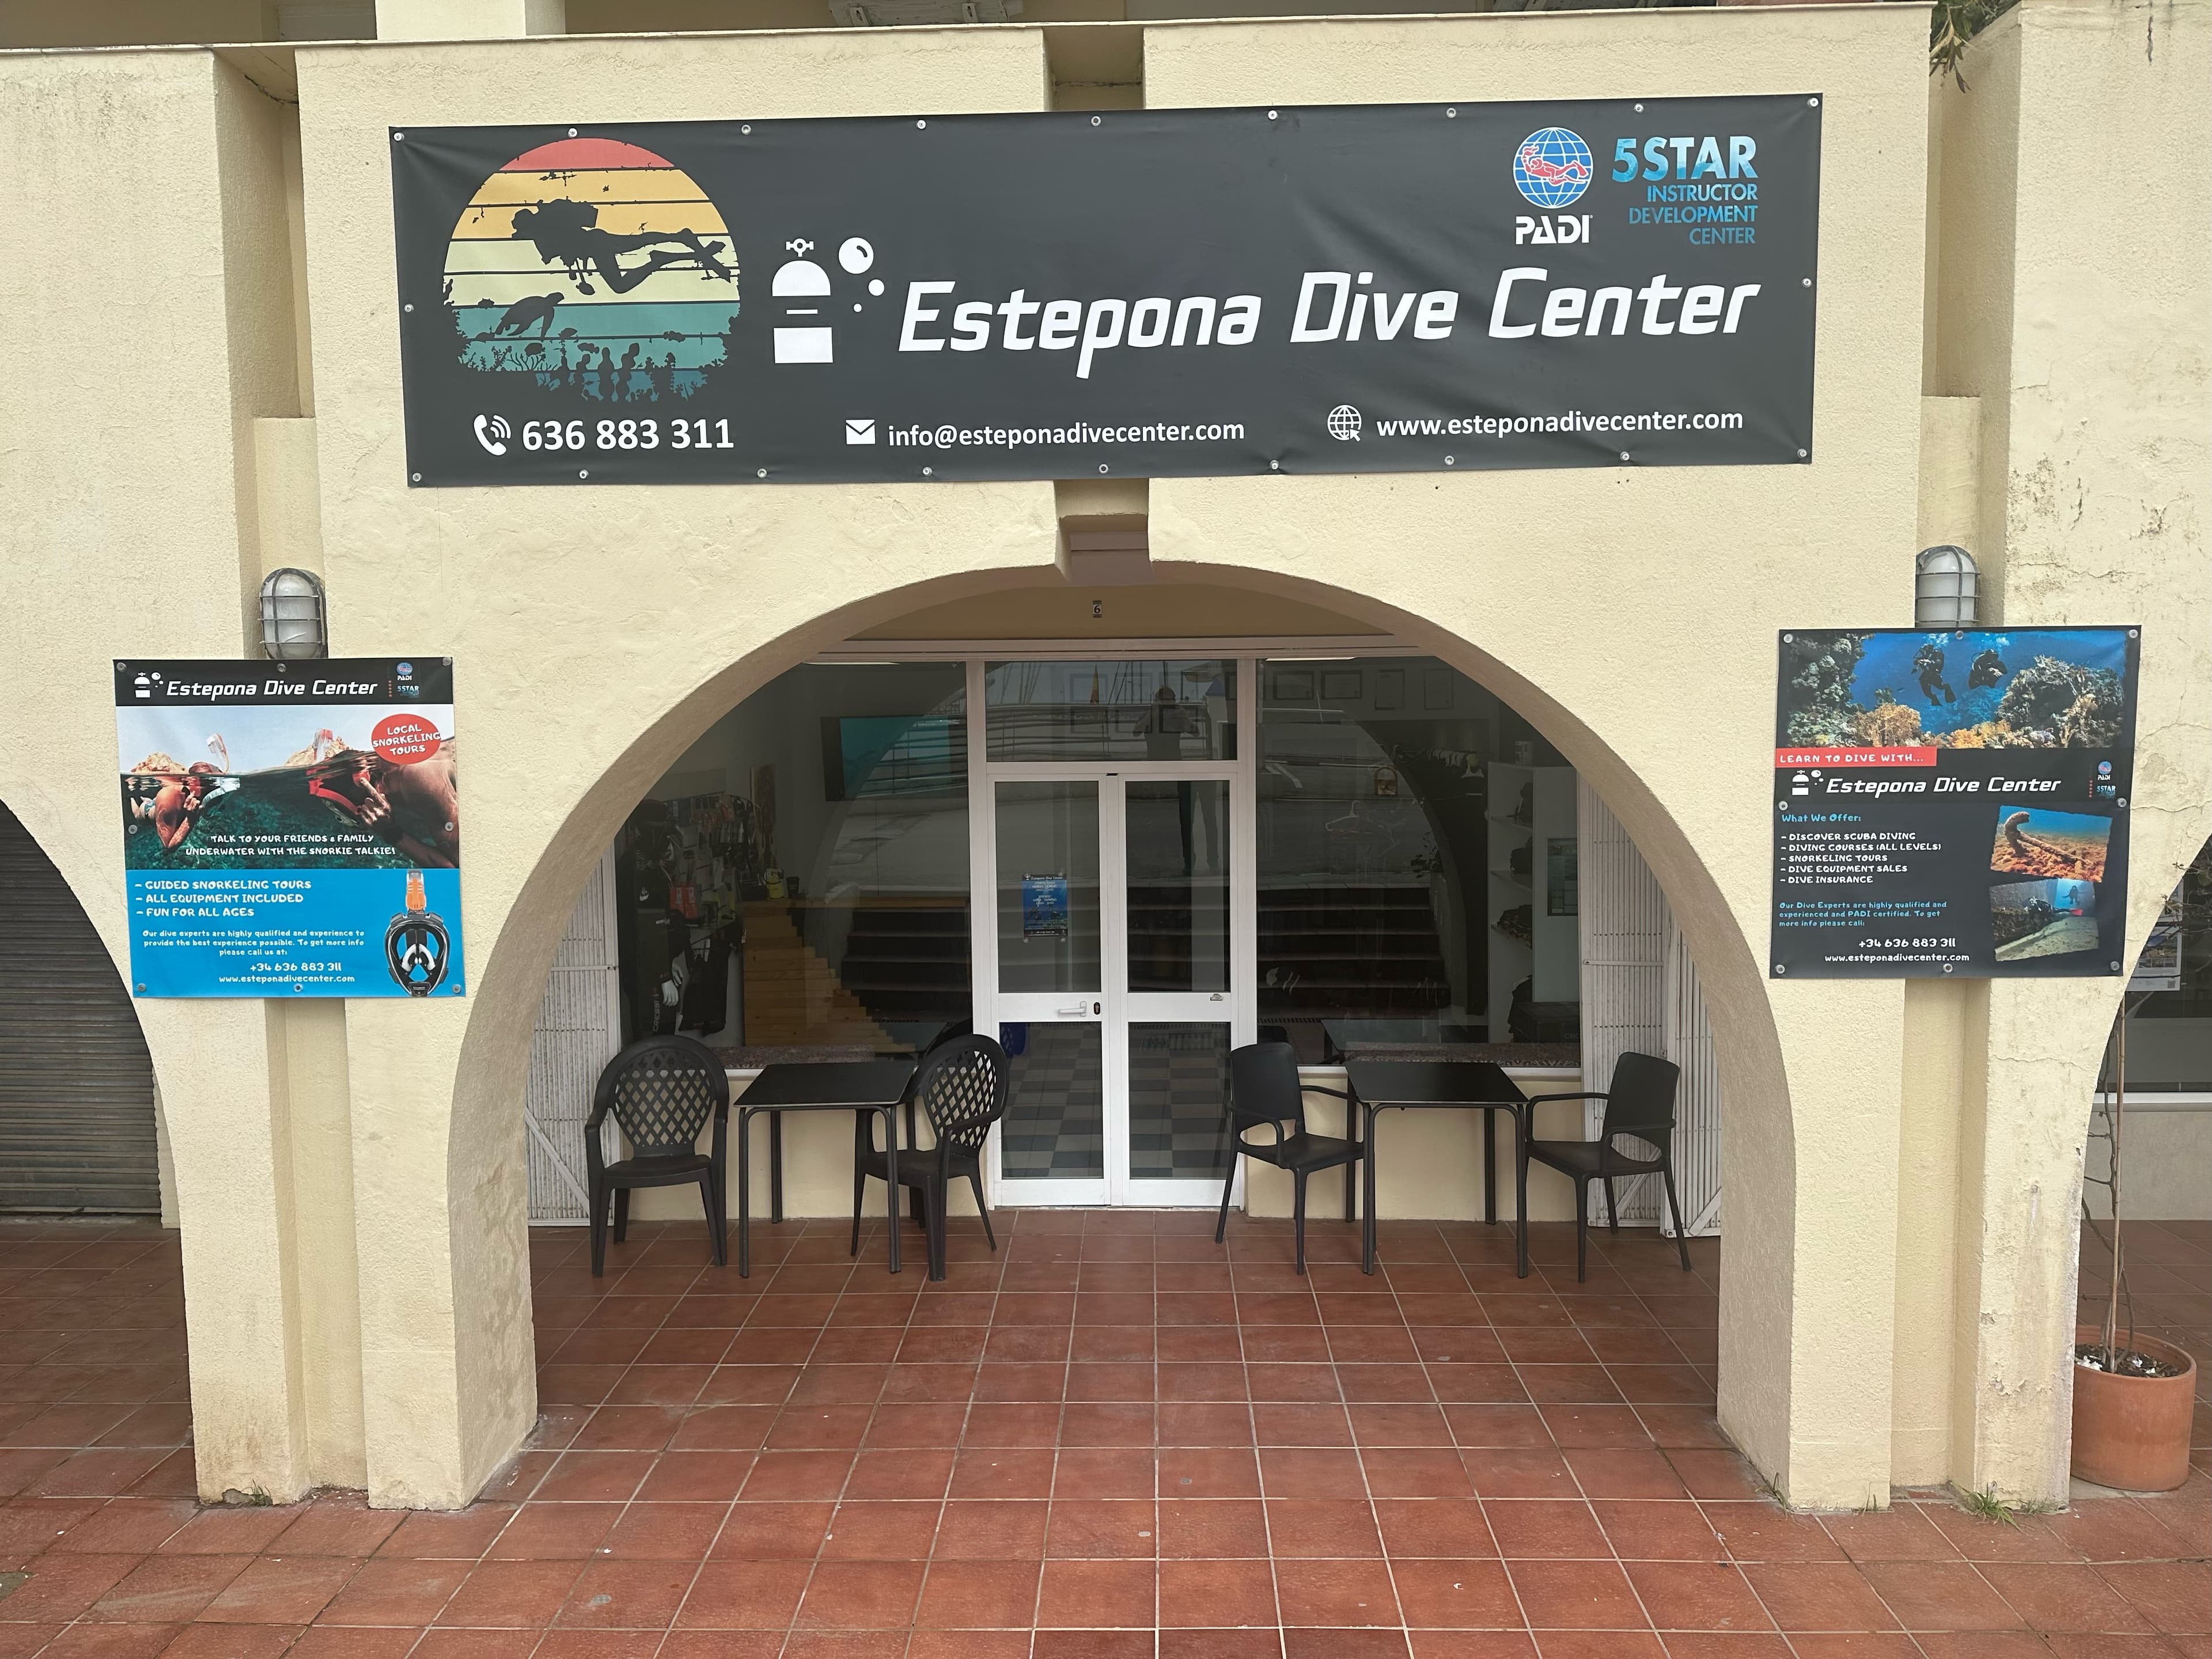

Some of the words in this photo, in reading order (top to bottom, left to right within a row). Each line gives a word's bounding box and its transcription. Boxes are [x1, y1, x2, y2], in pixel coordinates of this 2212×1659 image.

[1647, 184, 1758, 202] INSTRUCTOR
[1628, 206, 1758, 225] DEVELOPMENT
[1516, 215, 1589, 244] PADI
[1689, 228, 1755, 245] CENTER
[899, 281, 1261, 378] Estepona
[1290, 272, 1458, 342] Dive
[1488, 267, 1761, 338] Center
[1377, 411, 1743, 438] www.esteponadivecenter.com
[523, 421, 585, 450] 636
[597, 419, 659, 449] 883
[671, 419, 734, 449] 311
[889, 422, 1244, 449] info@esteponadivecenter.com
[1094, 605, 1101, 613] 6
[166, 681, 257, 701] Estepona
[264, 680, 305, 695] Dive
[312, 680, 378, 695] Center
[387, 724, 422, 735] LOCAL
[373, 732, 441, 748] SNORKELING
[389, 745, 425, 755] TOURS
[1845, 754, 1876, 762] DIVE
[1881, 753, 1923, 762] WITH...
[1826, 778, 1926, 798] Estepona
[1933, 778, 1980, 792] Dive
[1987, 777, 2061, 791] Center
[1782, 814, 1808, 822] What
[1830, 813, 1861, 821] Offer:
[210, 835, 236, 843] TALK
[186, 846, 255, 855] UNDERWATER
[286, 847, 307, 855] THE
[309, 847, 353, 855] SNORKIE
[145, 881, 189, 889] GUIDED
[192, 880, 269, 889] SNORKELING
[272, 880, 311, 889] TOURS
[146, 894, 167, 903] ALL
[170, 894, 239, 903] EQUIPMENT
[242, 894, 304, 903] INCLUDED
[1817, 902, 1850, 910] Experts
[146, 908, 169, 916] FUN
[172, 908, 195, 916] FOR
[198, 908, 219, 916] ALL
[223, 907, 254, 916] AGES
[1779, 911, 1828, 919] experienced
[144, 940, 174, 948] provide
[213, 940, 257, 948] experience
[259, 939, 295, 947] possible.
[1859, 939, 1881, 948] +34
[1885, 938, 1909, 947] 636
[1912, 938, 1937, 947] 883
[1940, 938, 1956, 947] 311
[1825, 953, 1969, 963] www.esteponadivecenter.com
[250, 963, 272, 971] +34
[274, 963, 298, 971] 636
[301, 963, 324, 971] 883
[327, 963, 341, 971] 311
[219, 975, 355, 984] www.esteponadivecenter.com
